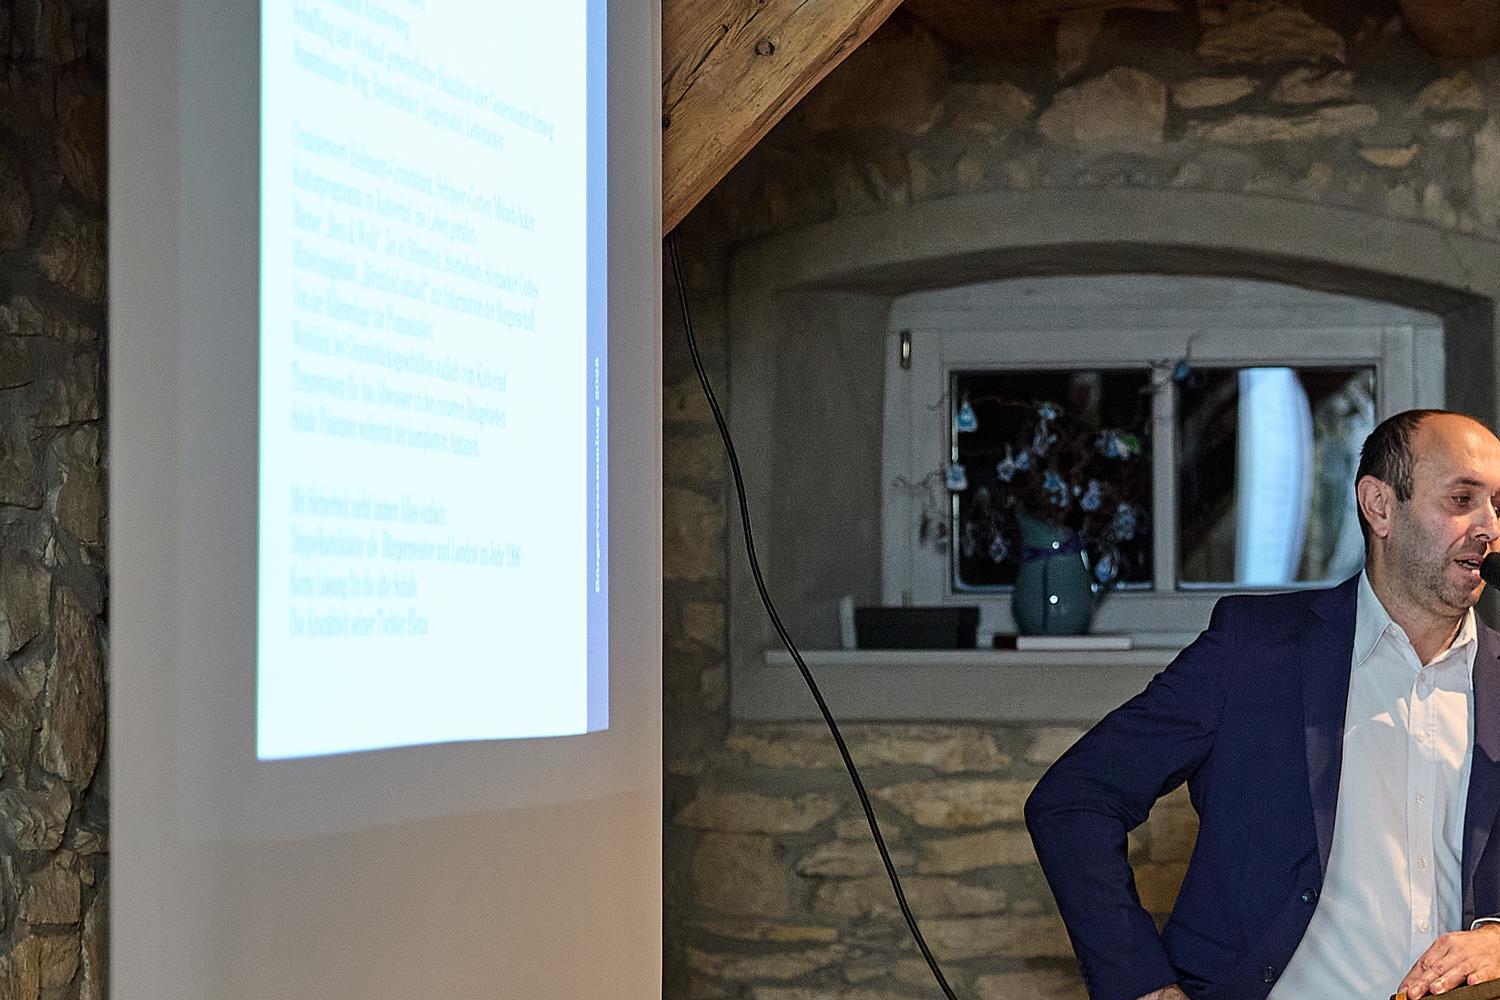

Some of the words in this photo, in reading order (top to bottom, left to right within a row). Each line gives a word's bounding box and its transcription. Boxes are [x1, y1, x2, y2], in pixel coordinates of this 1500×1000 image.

[382, 532, 434, 566] Bürgermeister
[435, 536, 450, 562] und
[451, 537, 478, 564] Landrat
[348, 569, 360, 596] für
[289, 608, 304, 636] Die
[377, 608, 406, 635] Tochter
